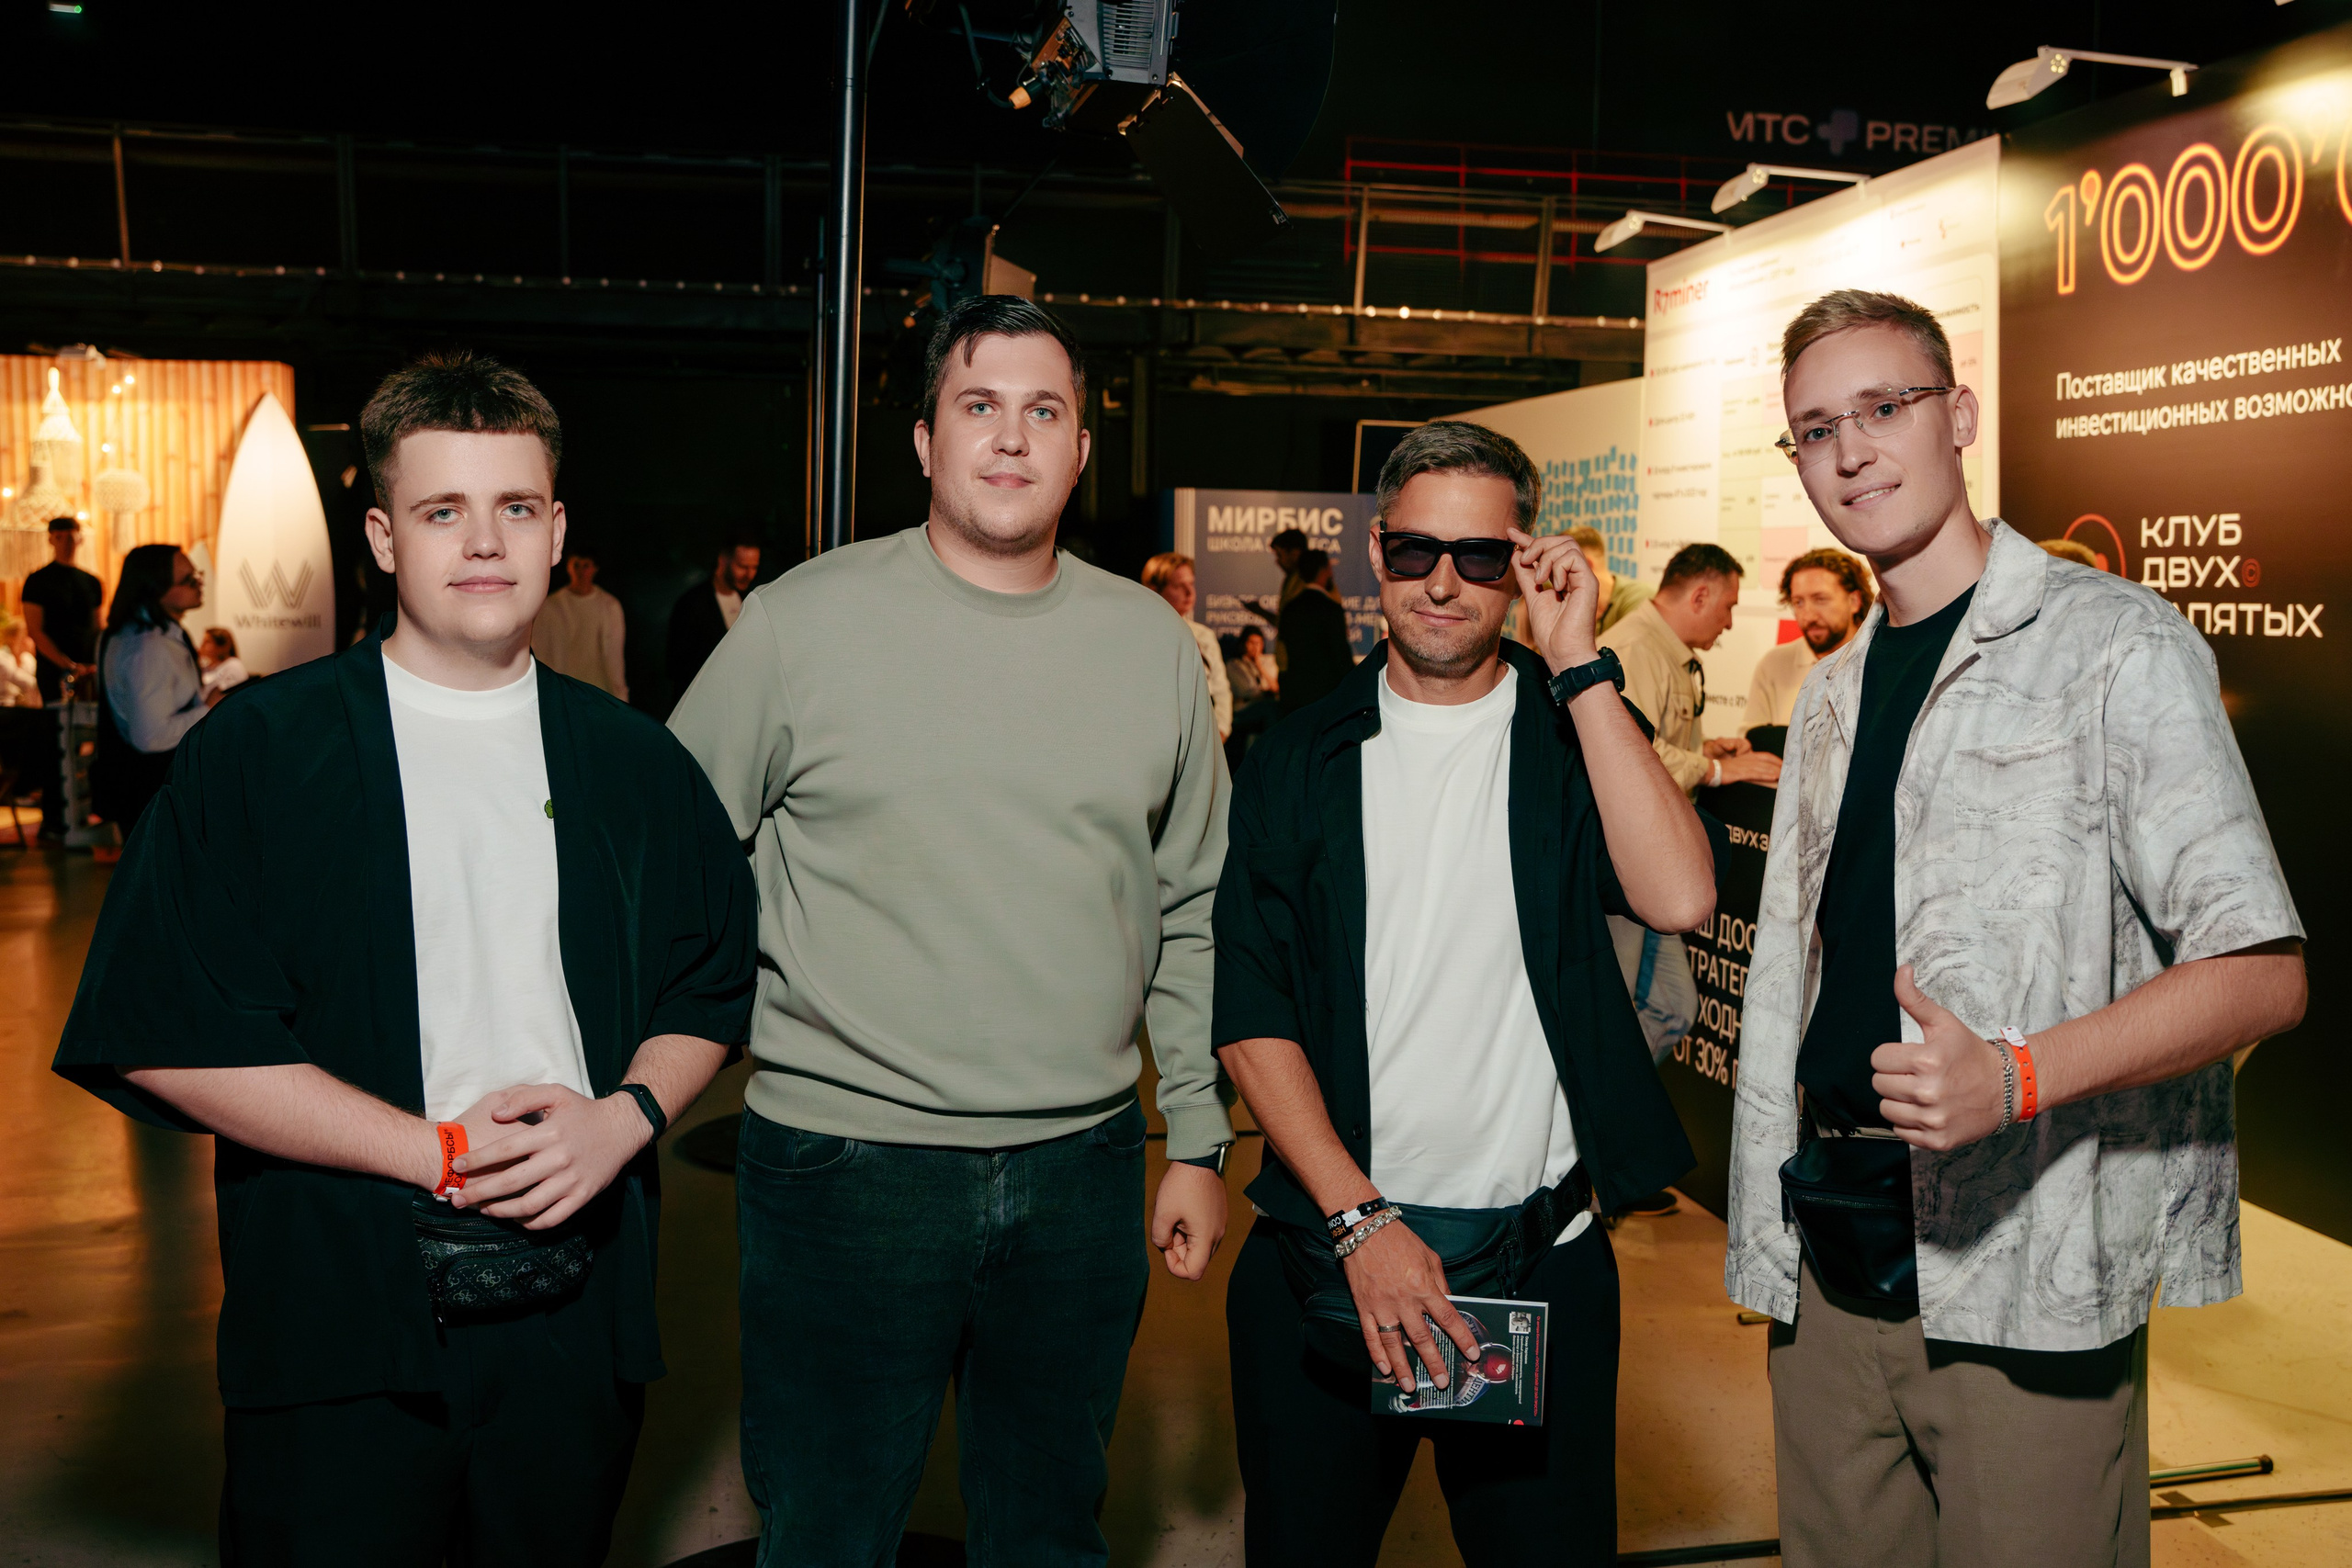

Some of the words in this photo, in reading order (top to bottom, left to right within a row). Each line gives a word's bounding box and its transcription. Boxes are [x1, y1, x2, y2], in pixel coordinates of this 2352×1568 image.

[1726, 110, 1810, 145] ИТС
[1866, 120, 1998, 153] PREM
[2056, 364, 2166, 401] Поставщик
[2170, 337, 2343, 387] качественных
[2055, 399, 2230, 440] инвестиционных
[1207, 505, 1344, 536] МИРБИС
[2141, 513, 2243, 548] КЛУБ
[2141, 555, 2242, 593] ДВУХ
[232, 613, 322, 630] Whitewill
[2174, 602, 2324, 638] ПЯТЫХ
[1695, 1036, 1729, 1087] 30%
